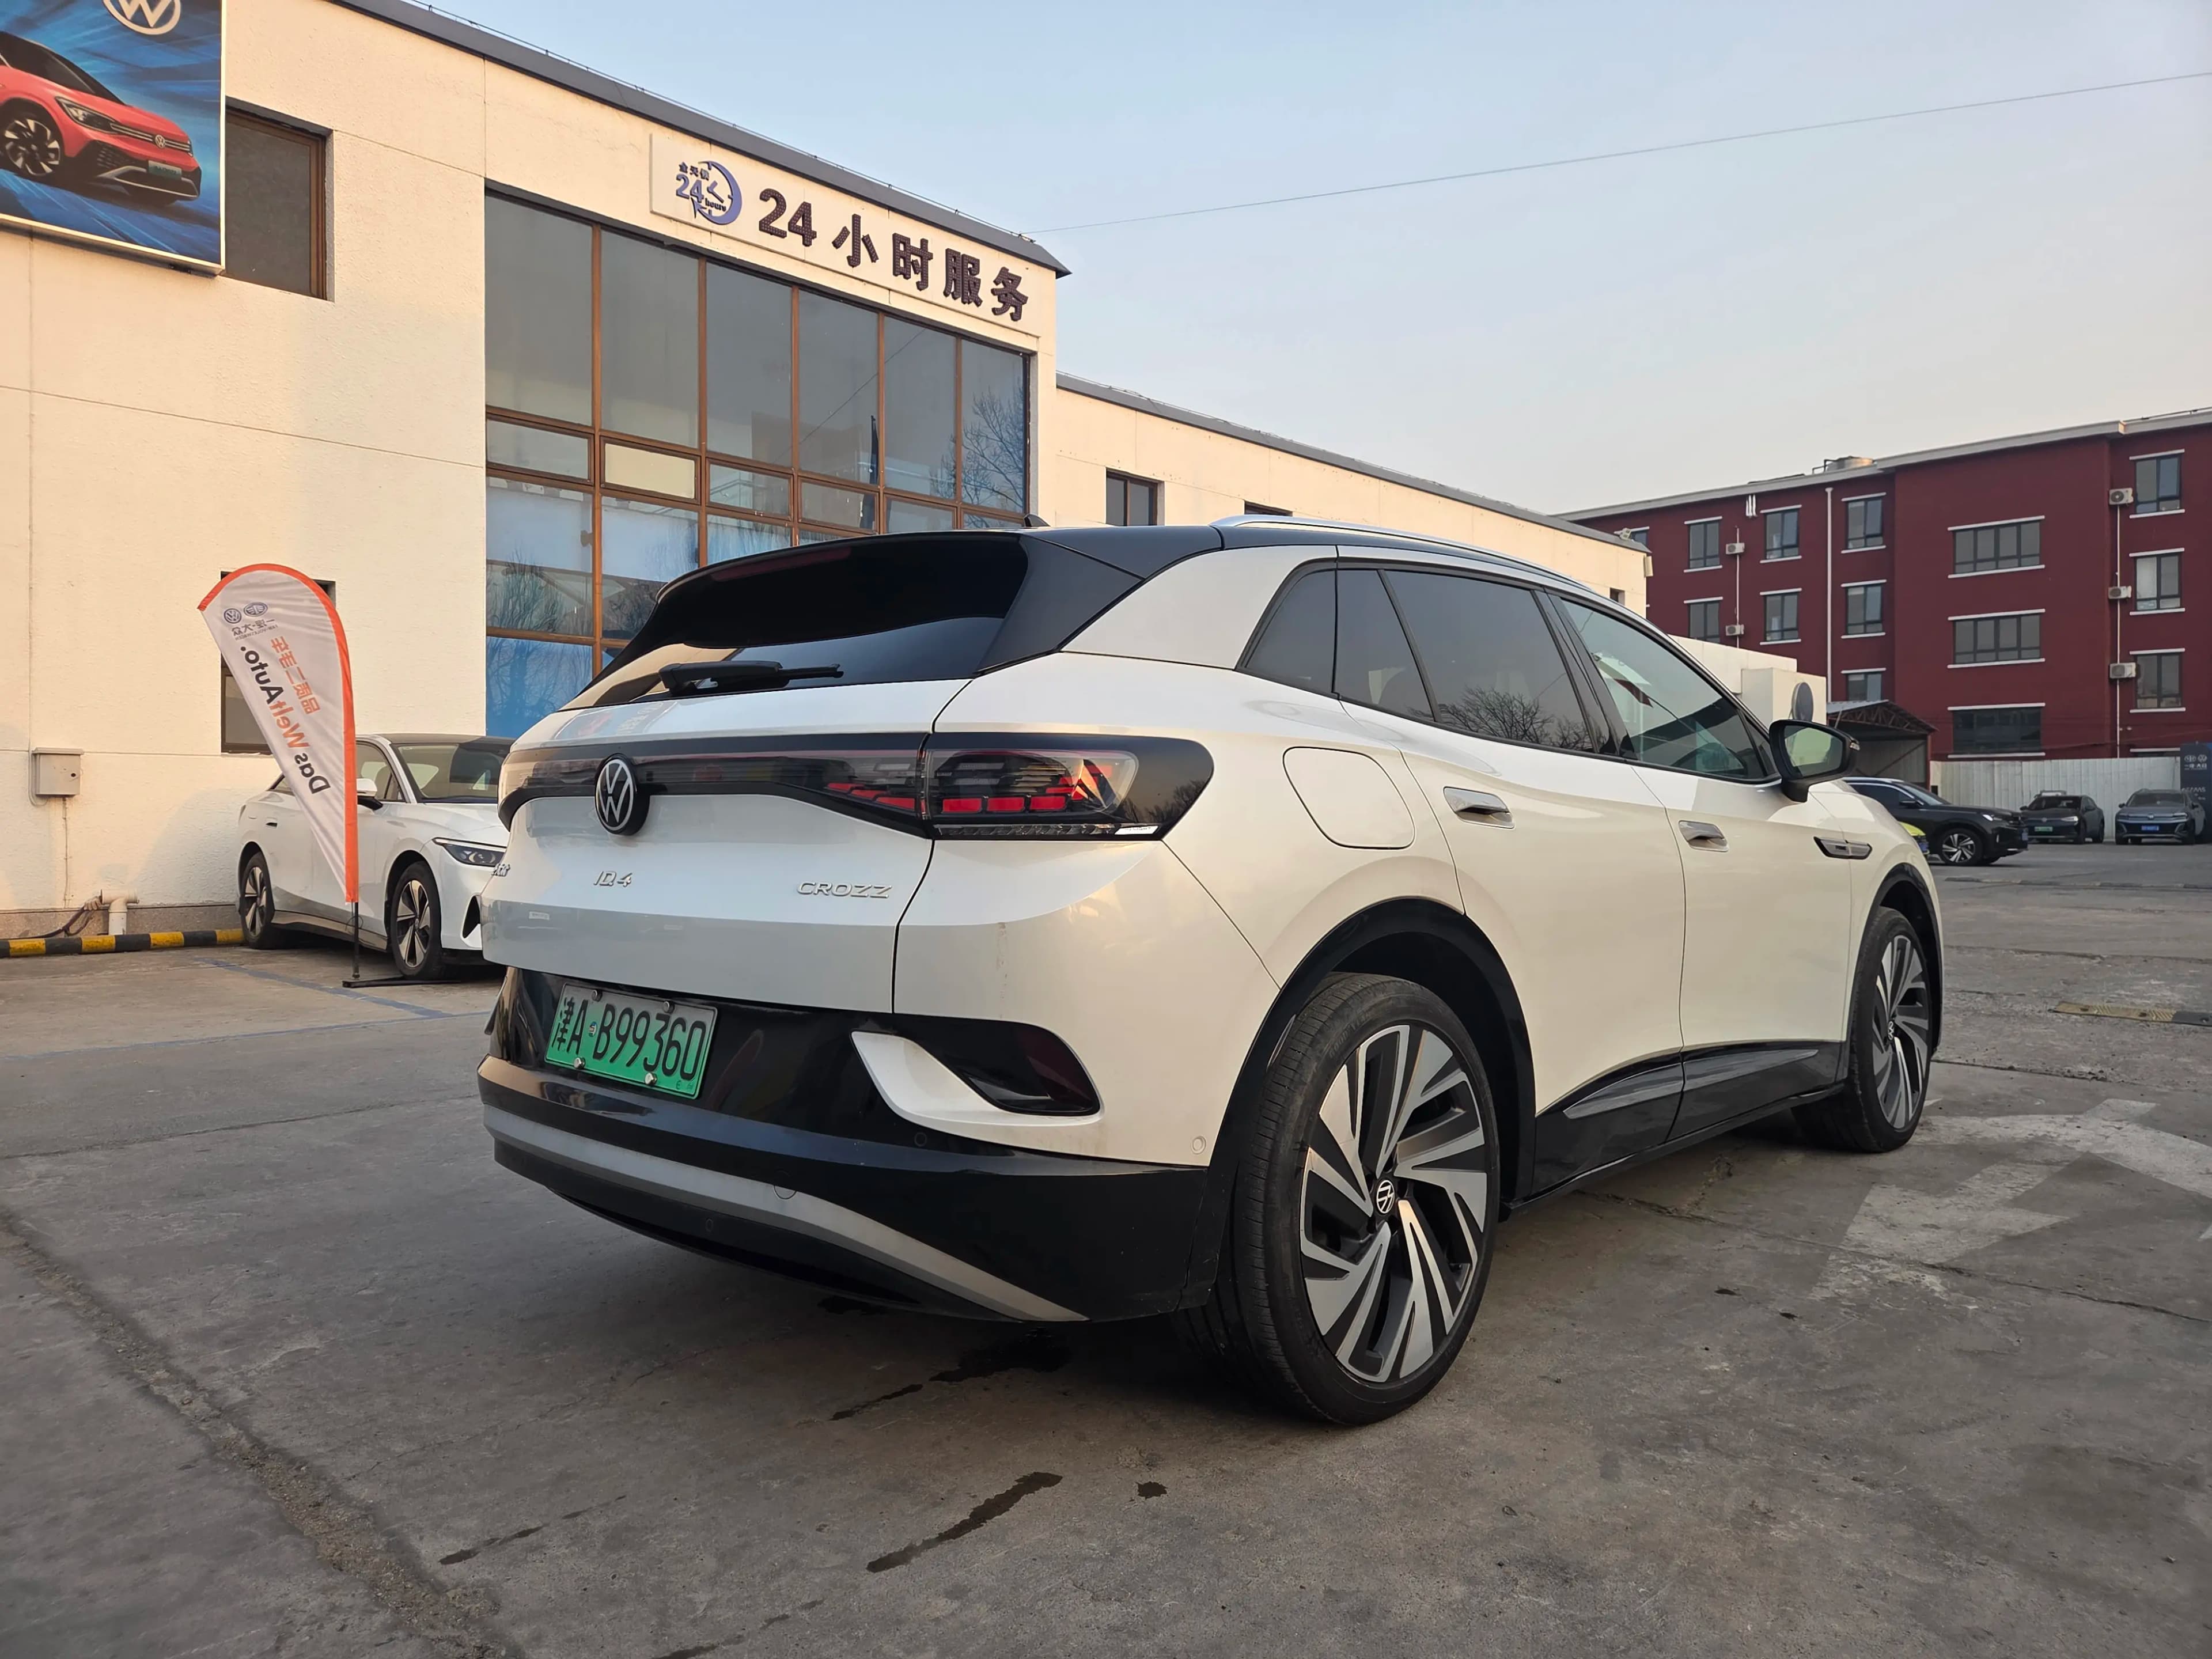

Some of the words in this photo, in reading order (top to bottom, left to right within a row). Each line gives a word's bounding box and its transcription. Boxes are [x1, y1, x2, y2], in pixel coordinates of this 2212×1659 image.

[676, 173, 704, 203] 24
[704, 198, 726, 211] hours
[797, 881, 892, 899] CROZZ
